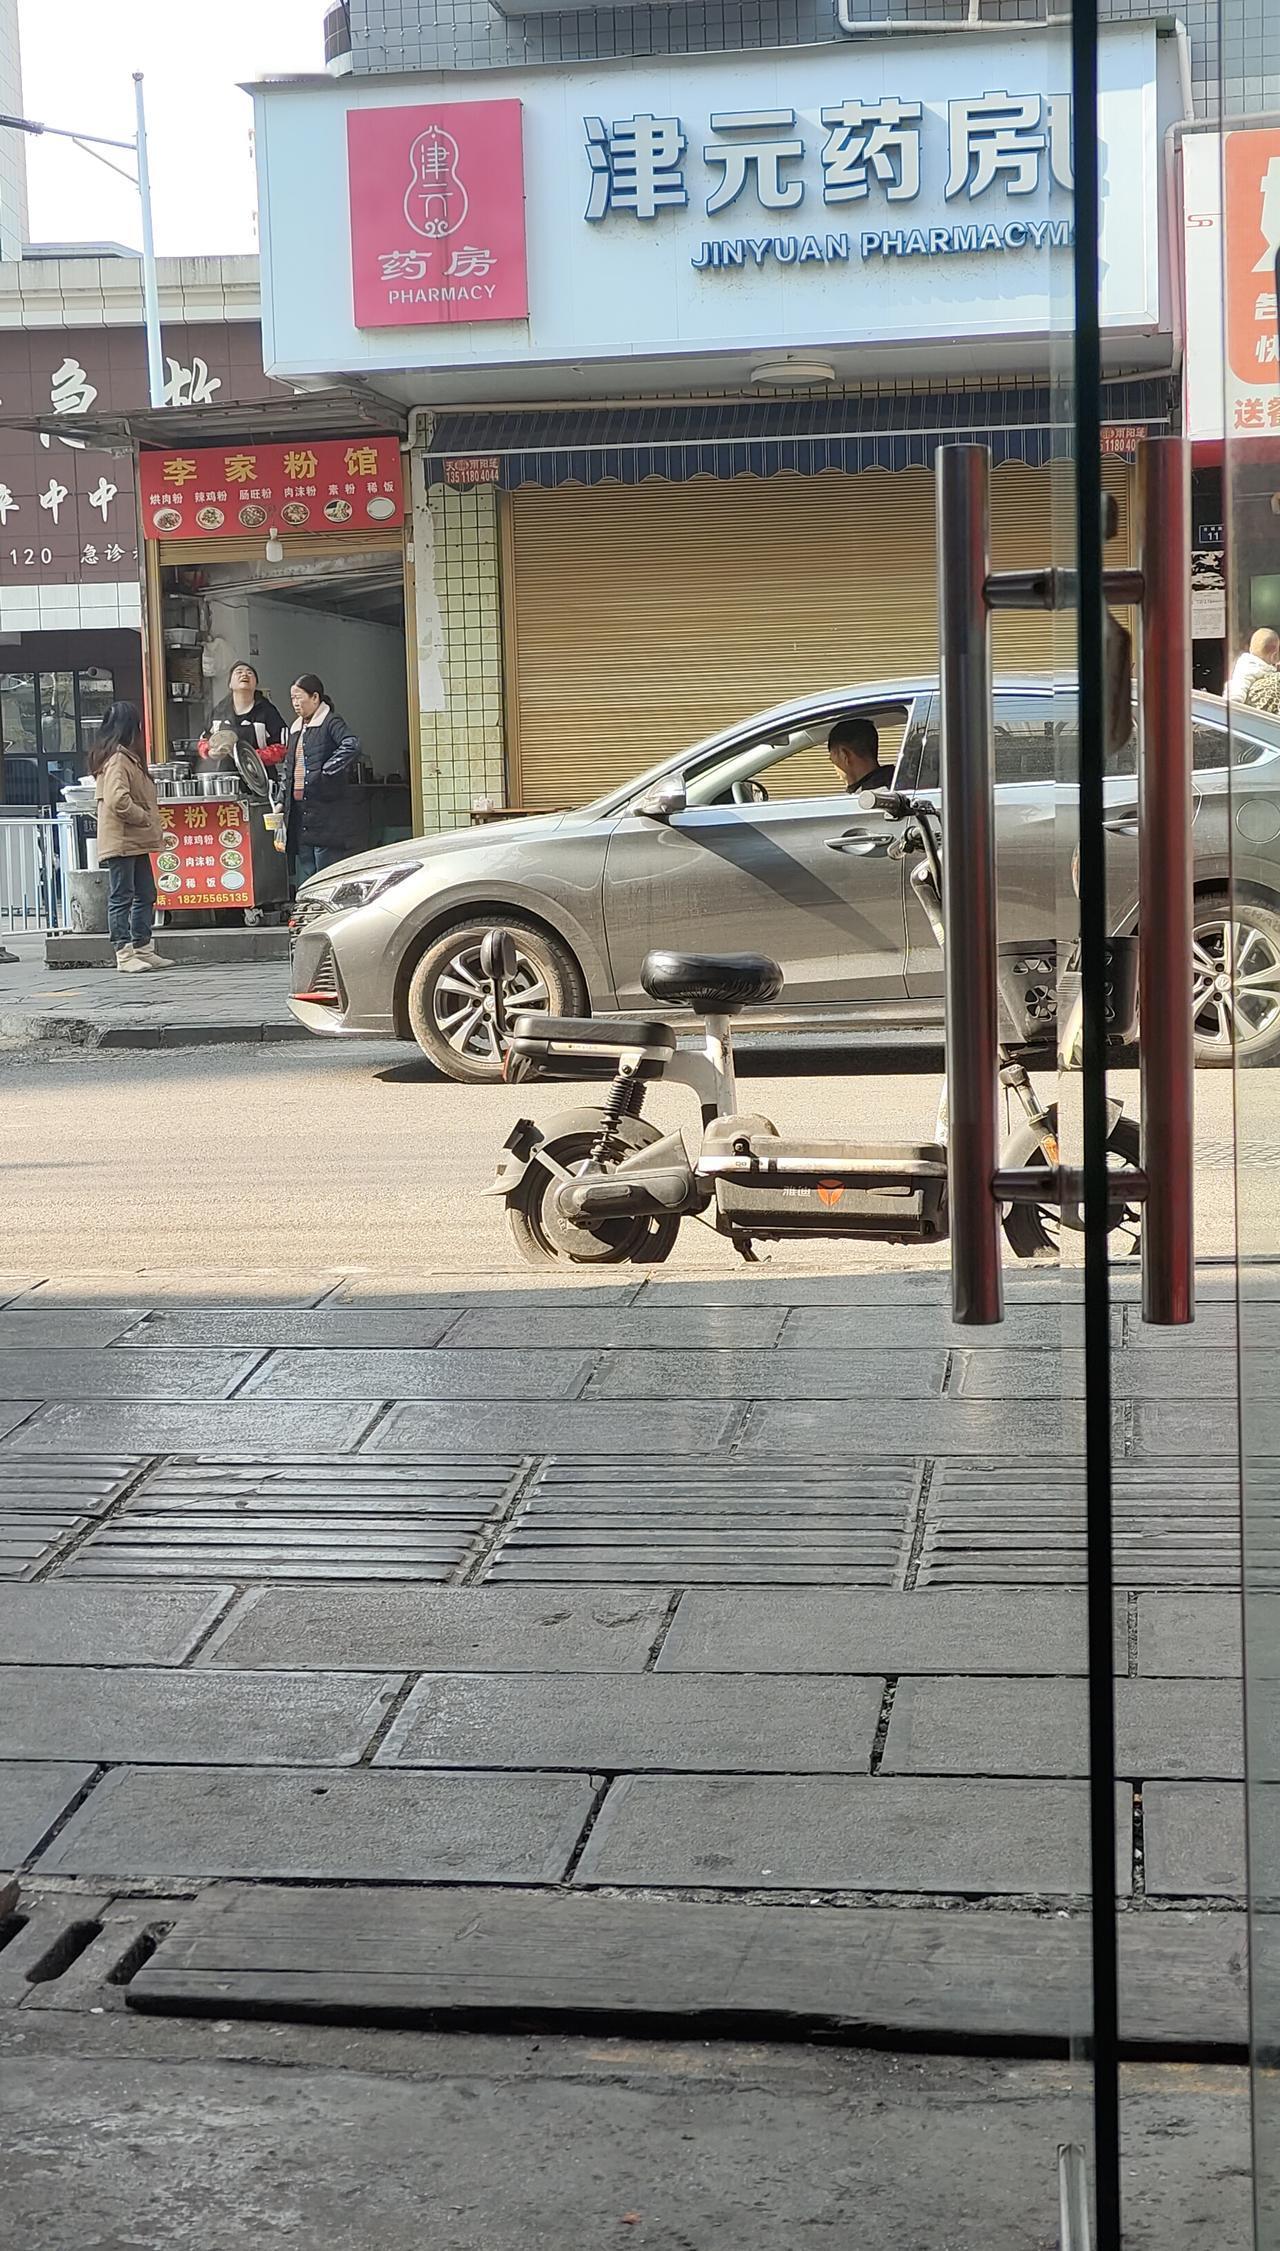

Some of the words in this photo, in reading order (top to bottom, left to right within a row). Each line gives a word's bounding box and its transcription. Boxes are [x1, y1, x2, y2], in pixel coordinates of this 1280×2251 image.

[583, 90, 1047, 222] 津元药房
[378, 246, 497, 281] 药房
[691, 231, 850, 269] JINYUAN
[388, 284, 496, 304] PHARMACY
[163, 447, 379, 486] 李家粉馆
[194, 490, 228, 503] 辣鸡粉
[239, 488, 273, 500] 肠旺粉
[10, 547, 52, 565] 120
[80, 543, 138, 565] 急诊
